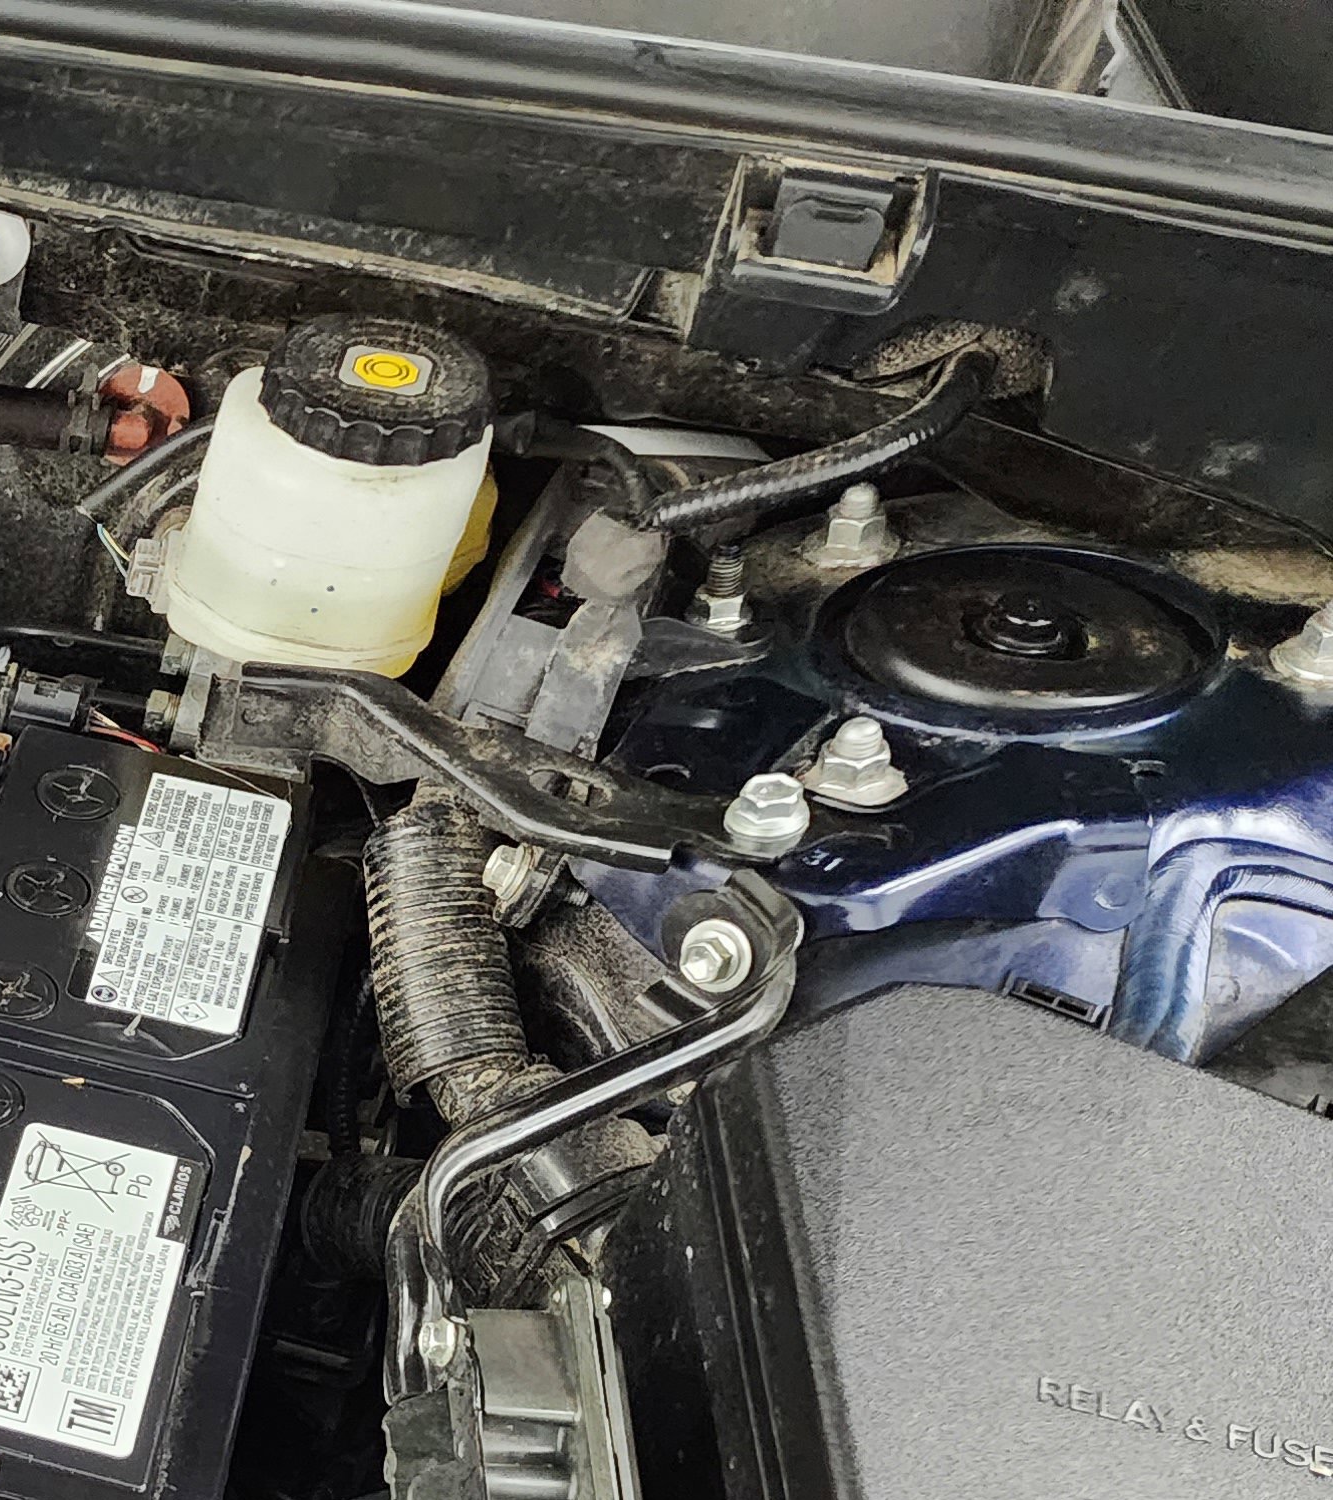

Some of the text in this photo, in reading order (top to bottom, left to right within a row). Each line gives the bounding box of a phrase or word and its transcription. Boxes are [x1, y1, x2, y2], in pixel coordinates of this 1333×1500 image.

[90, 824, 135, 933] DANGER/POISON
[126, 1174, 153, 1199] Pb
[168, 1165, 192, 1215] CLARIOS
[29, 1251, 50, 1292] APPLICABLE
[21, 1292, 36, 1315] START
[38, 1223, 99, 1366] 20 Hr 65 Ah CCA 603 A (SAE)
[9, 1341, 22, 1356] FOR
[14, 1321, 27, 1341] STOP
[20, 1348, 33, 1358] TO
[67, 1398, 117, 1435] TM
[1036, 1376, 1174, 1433] RELAY
[1184, 1416, 1210, 1444] &
